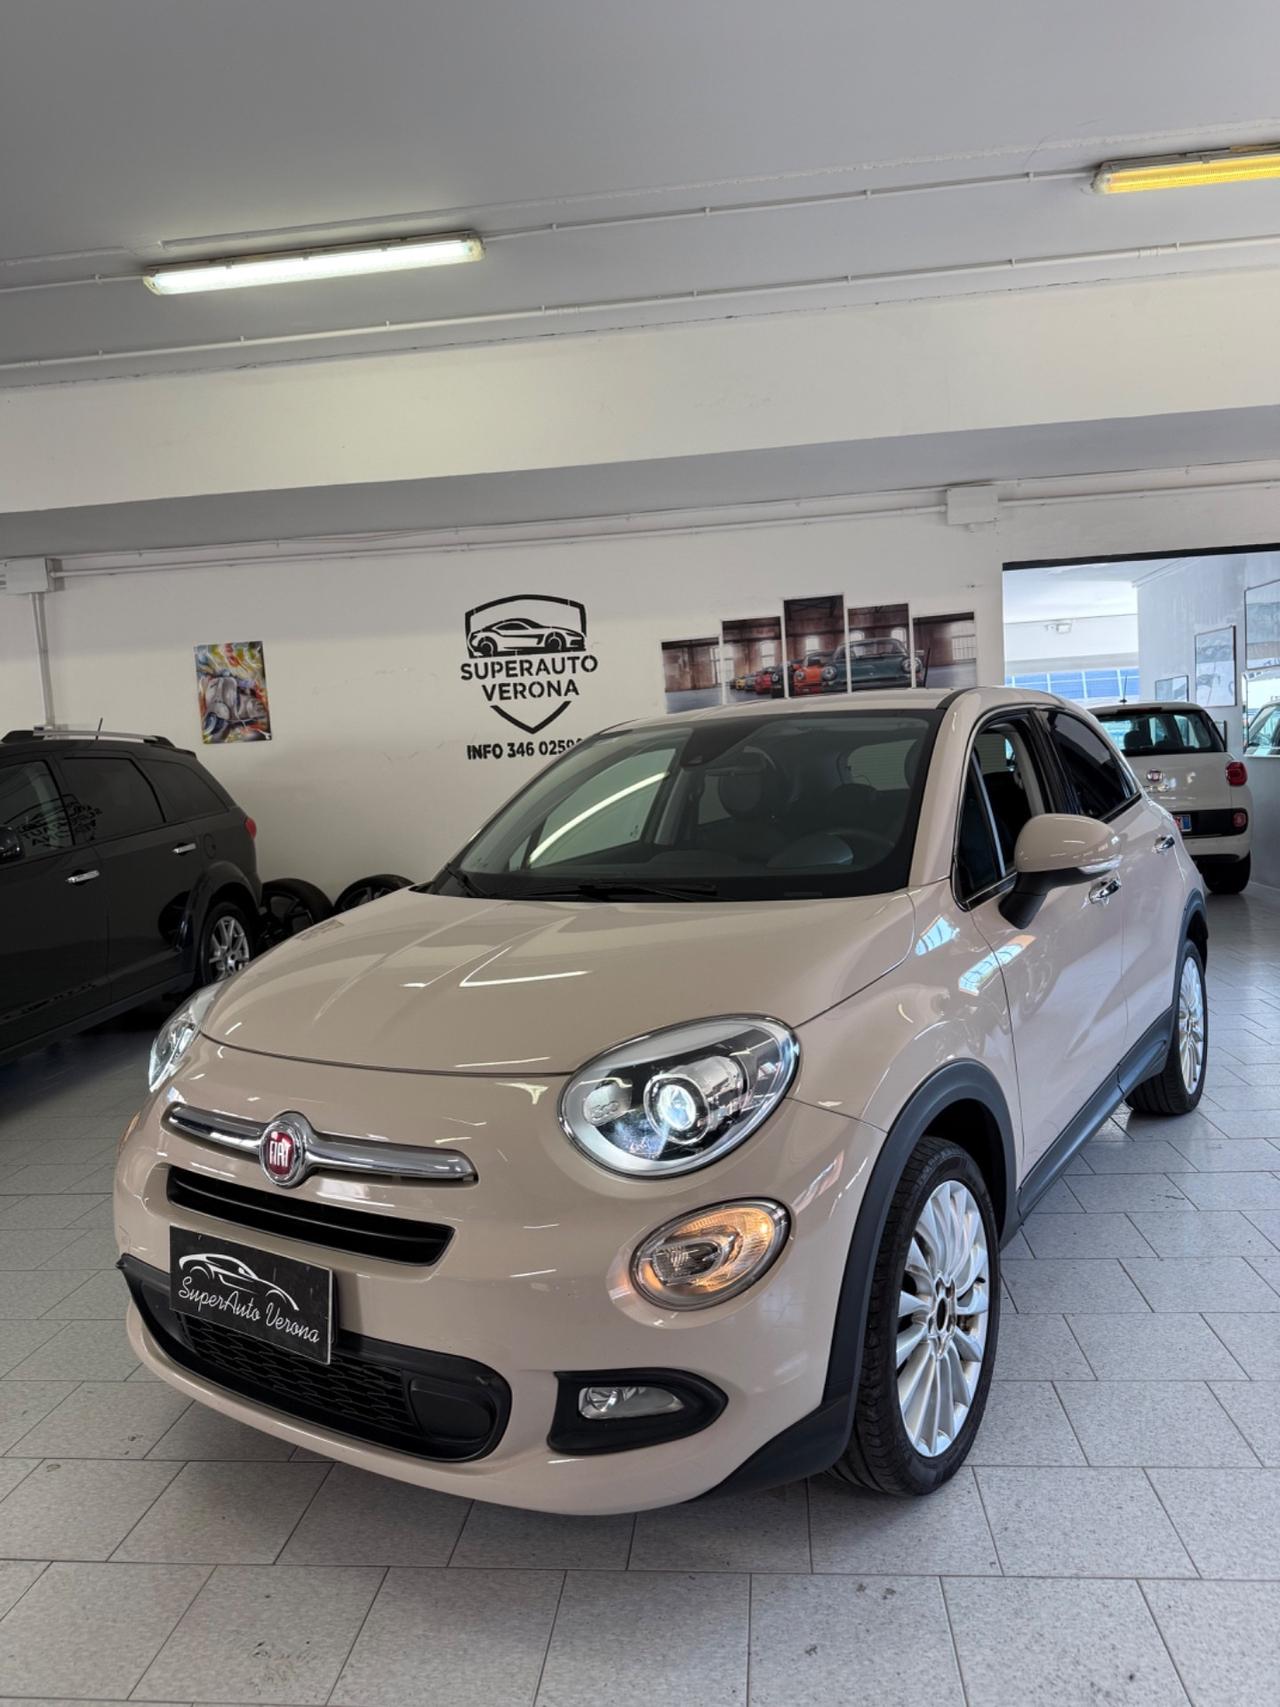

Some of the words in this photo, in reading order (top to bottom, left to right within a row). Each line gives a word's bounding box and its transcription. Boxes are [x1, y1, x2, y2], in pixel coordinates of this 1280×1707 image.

[460, 655, 598, 680] SUPERAUTO
[481, 679, 580, 701] VERONA
[466, 743, 503, 760] INFO
[507, 741, 535, 758] 346
[178, 1276, 261, 1321] SuperAuto
[265, 1302, 320, 1343] Verona
